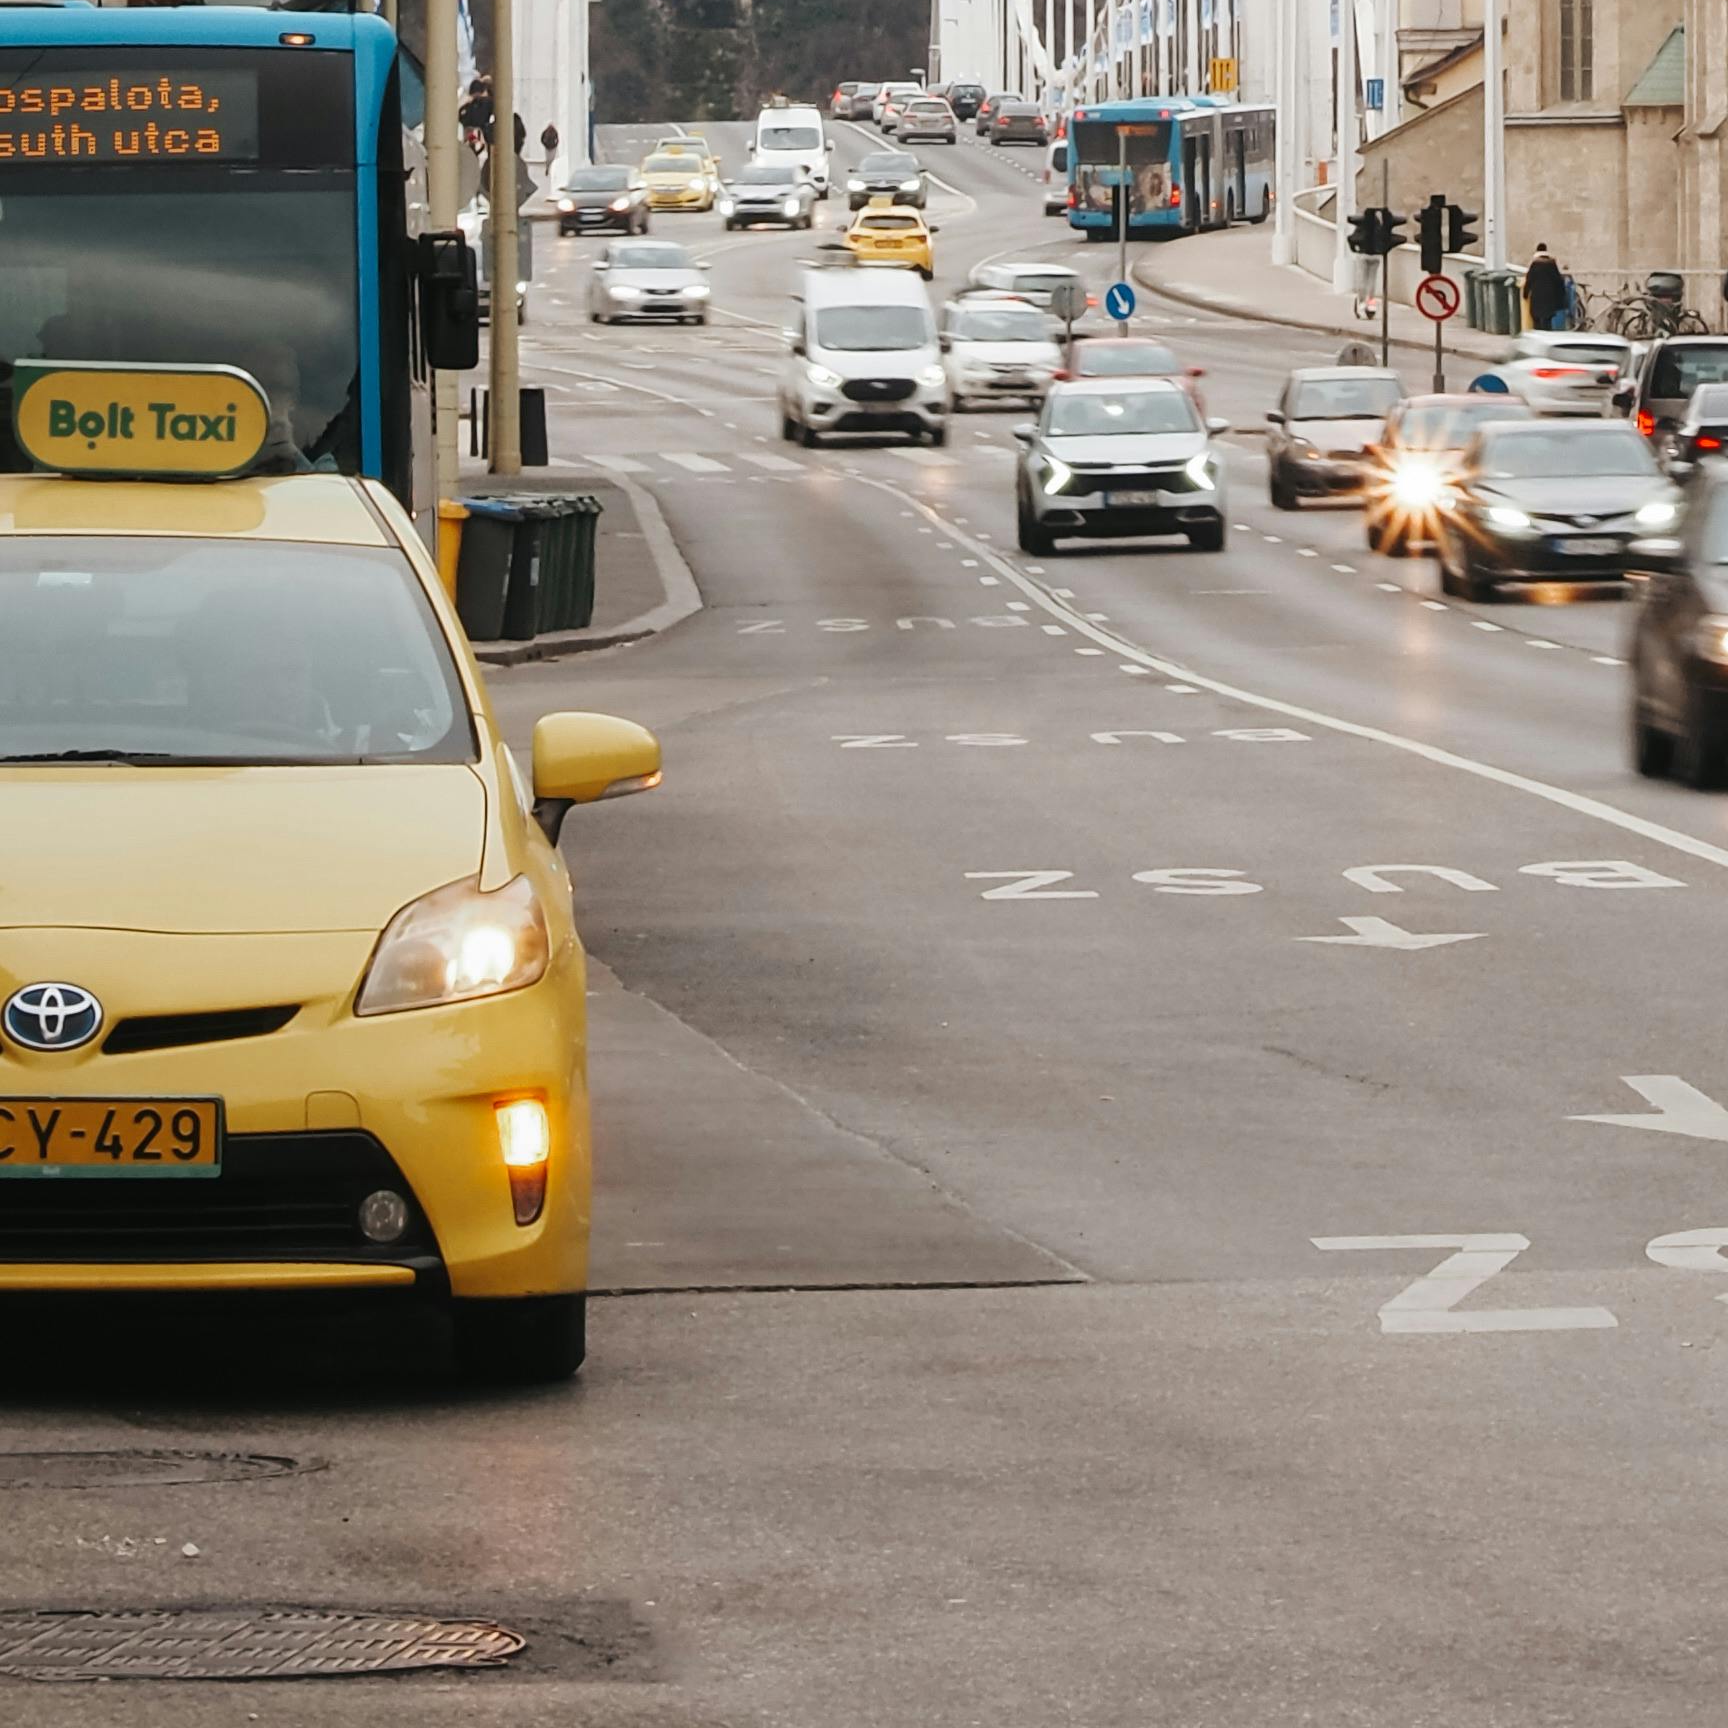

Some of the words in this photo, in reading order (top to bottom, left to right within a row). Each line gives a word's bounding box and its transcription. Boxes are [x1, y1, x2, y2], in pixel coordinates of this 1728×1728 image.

[114, 122, 220, 154] utca
[49, 400, 134, 449] Bolt
[148, 403, 236, 441] Taxi
[964, 860, 1689, 900] BUSZ
